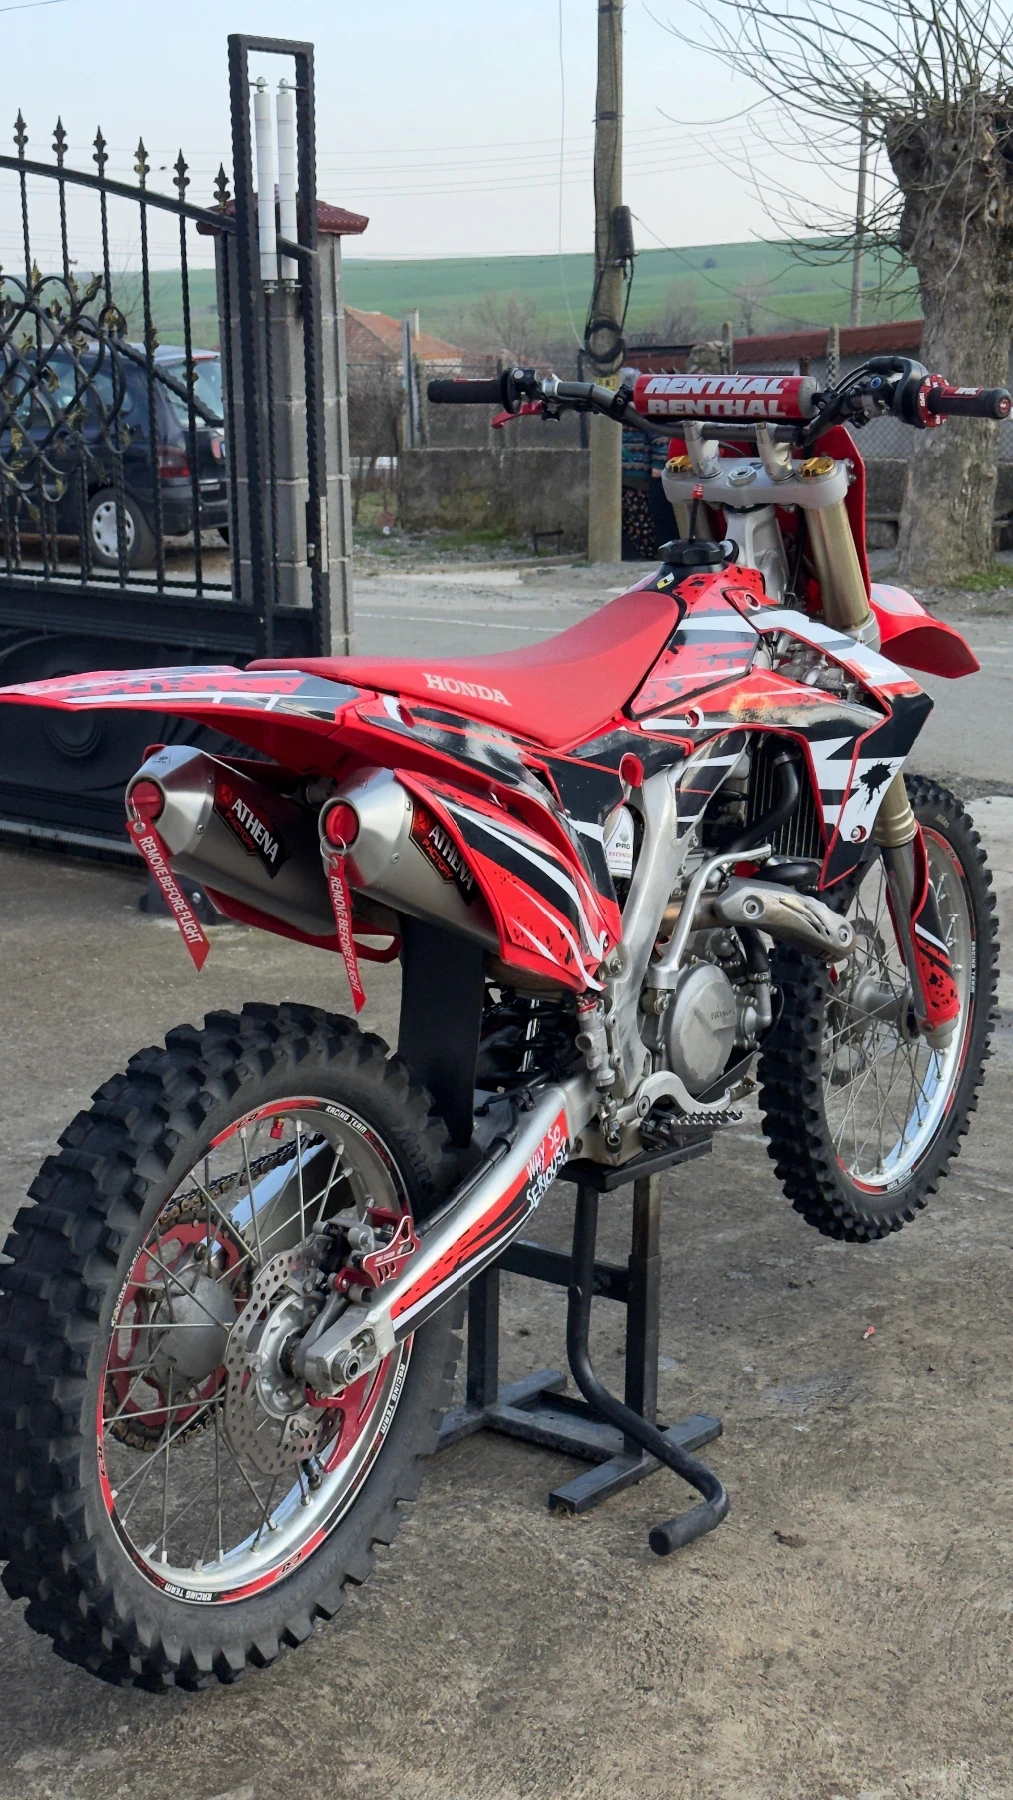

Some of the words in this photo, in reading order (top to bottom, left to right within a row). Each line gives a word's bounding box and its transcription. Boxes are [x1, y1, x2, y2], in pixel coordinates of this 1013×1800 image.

[643, 377, 785, 395] RENTHAL
[647, 399, 787, 416] RENTHAL
[421, 672, 512, 707] HONDA
[225, 811, 257, 850] FACTORY
[231, 798, 279, 863] ATHENA
[615, 842, 631, 850] PRO
[422, 838, 453, 878] FACTORY
[428, 824, 474, 891] ATHENA
[138, 835, 168, 877] REMOVE
[159, 874, 185, 913] BEFORE
[178, 910, 203, 943] FLIGHT
[330, 875, 347, 920] REMOVE
[338, 920, 354, 960] BEFORE
[346, 957, 362, 994] FLIGHT
[325, 1105, 350, 1121] RACING
[349, 1117, 368, 1135] TEAM
[526, 1140, 545, 1183] WHY
[547, 1124, 561, 1150] SO
[526, 1135, 569, 1211] SERIOUS?
[391, 1363, 406, 1402] RACING
[380, 1404, 395, 1434] TEAM
